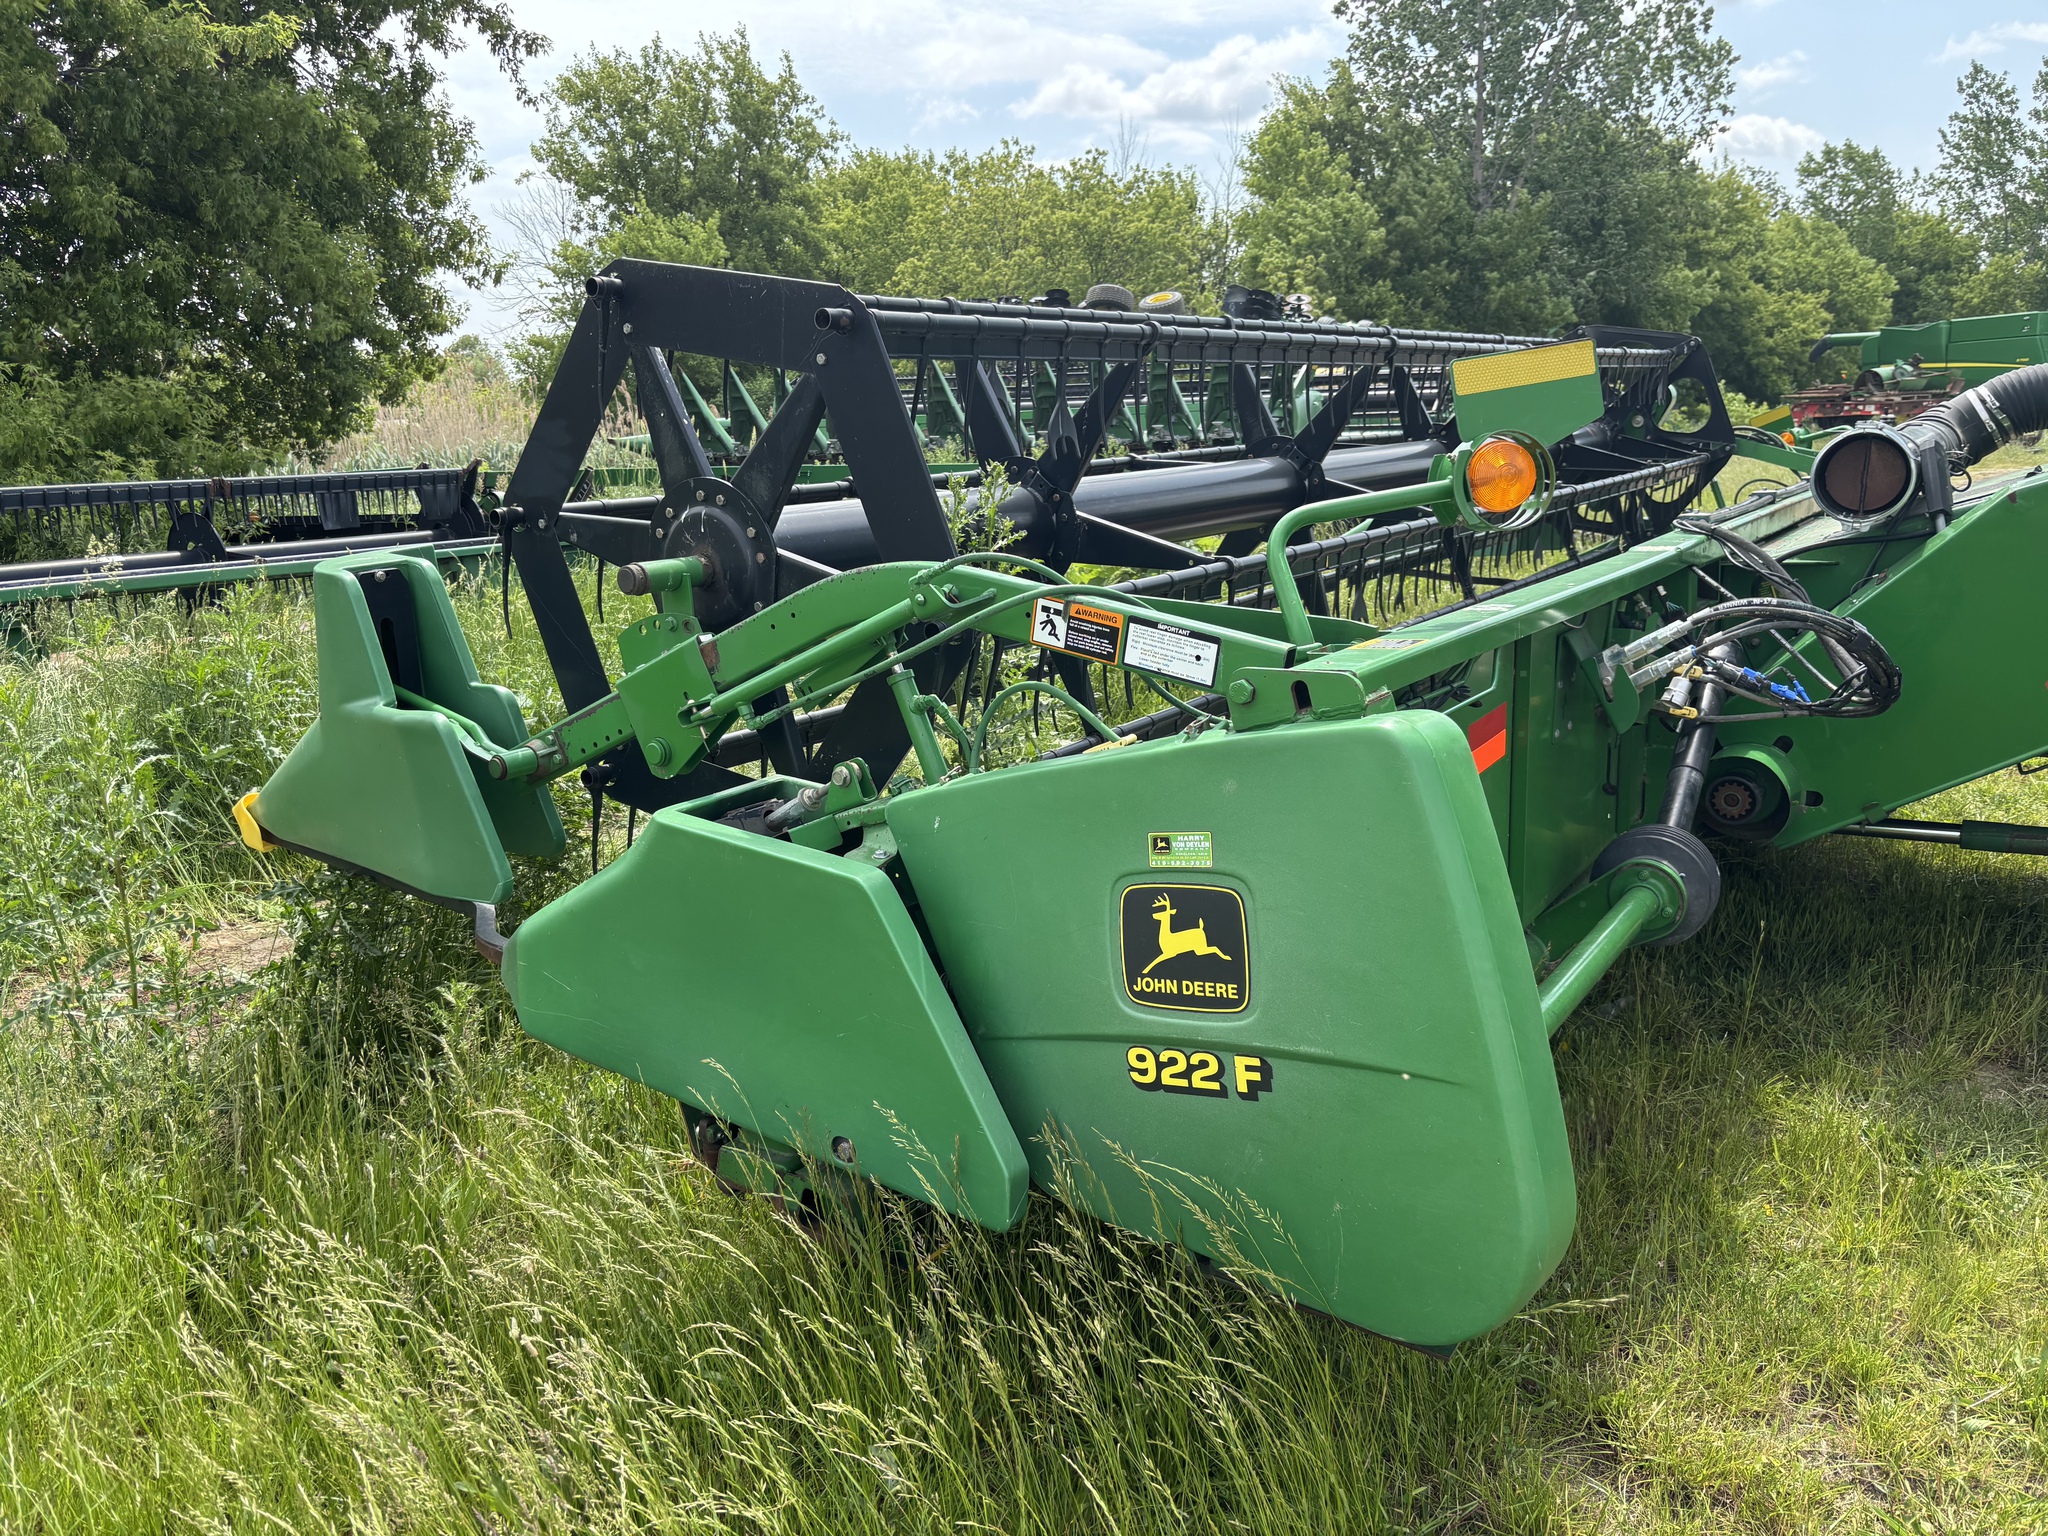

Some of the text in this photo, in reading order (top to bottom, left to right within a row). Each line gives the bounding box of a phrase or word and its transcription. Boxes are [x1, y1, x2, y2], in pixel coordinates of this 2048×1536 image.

[1082, 609, 1117, 623] WARNING
[1158, 623, 1190, 636] IMPORTANT
[1133, 976, 1239, 999] JOHN DEERE
[1126, 1046, 1267, 1097] 922 F
